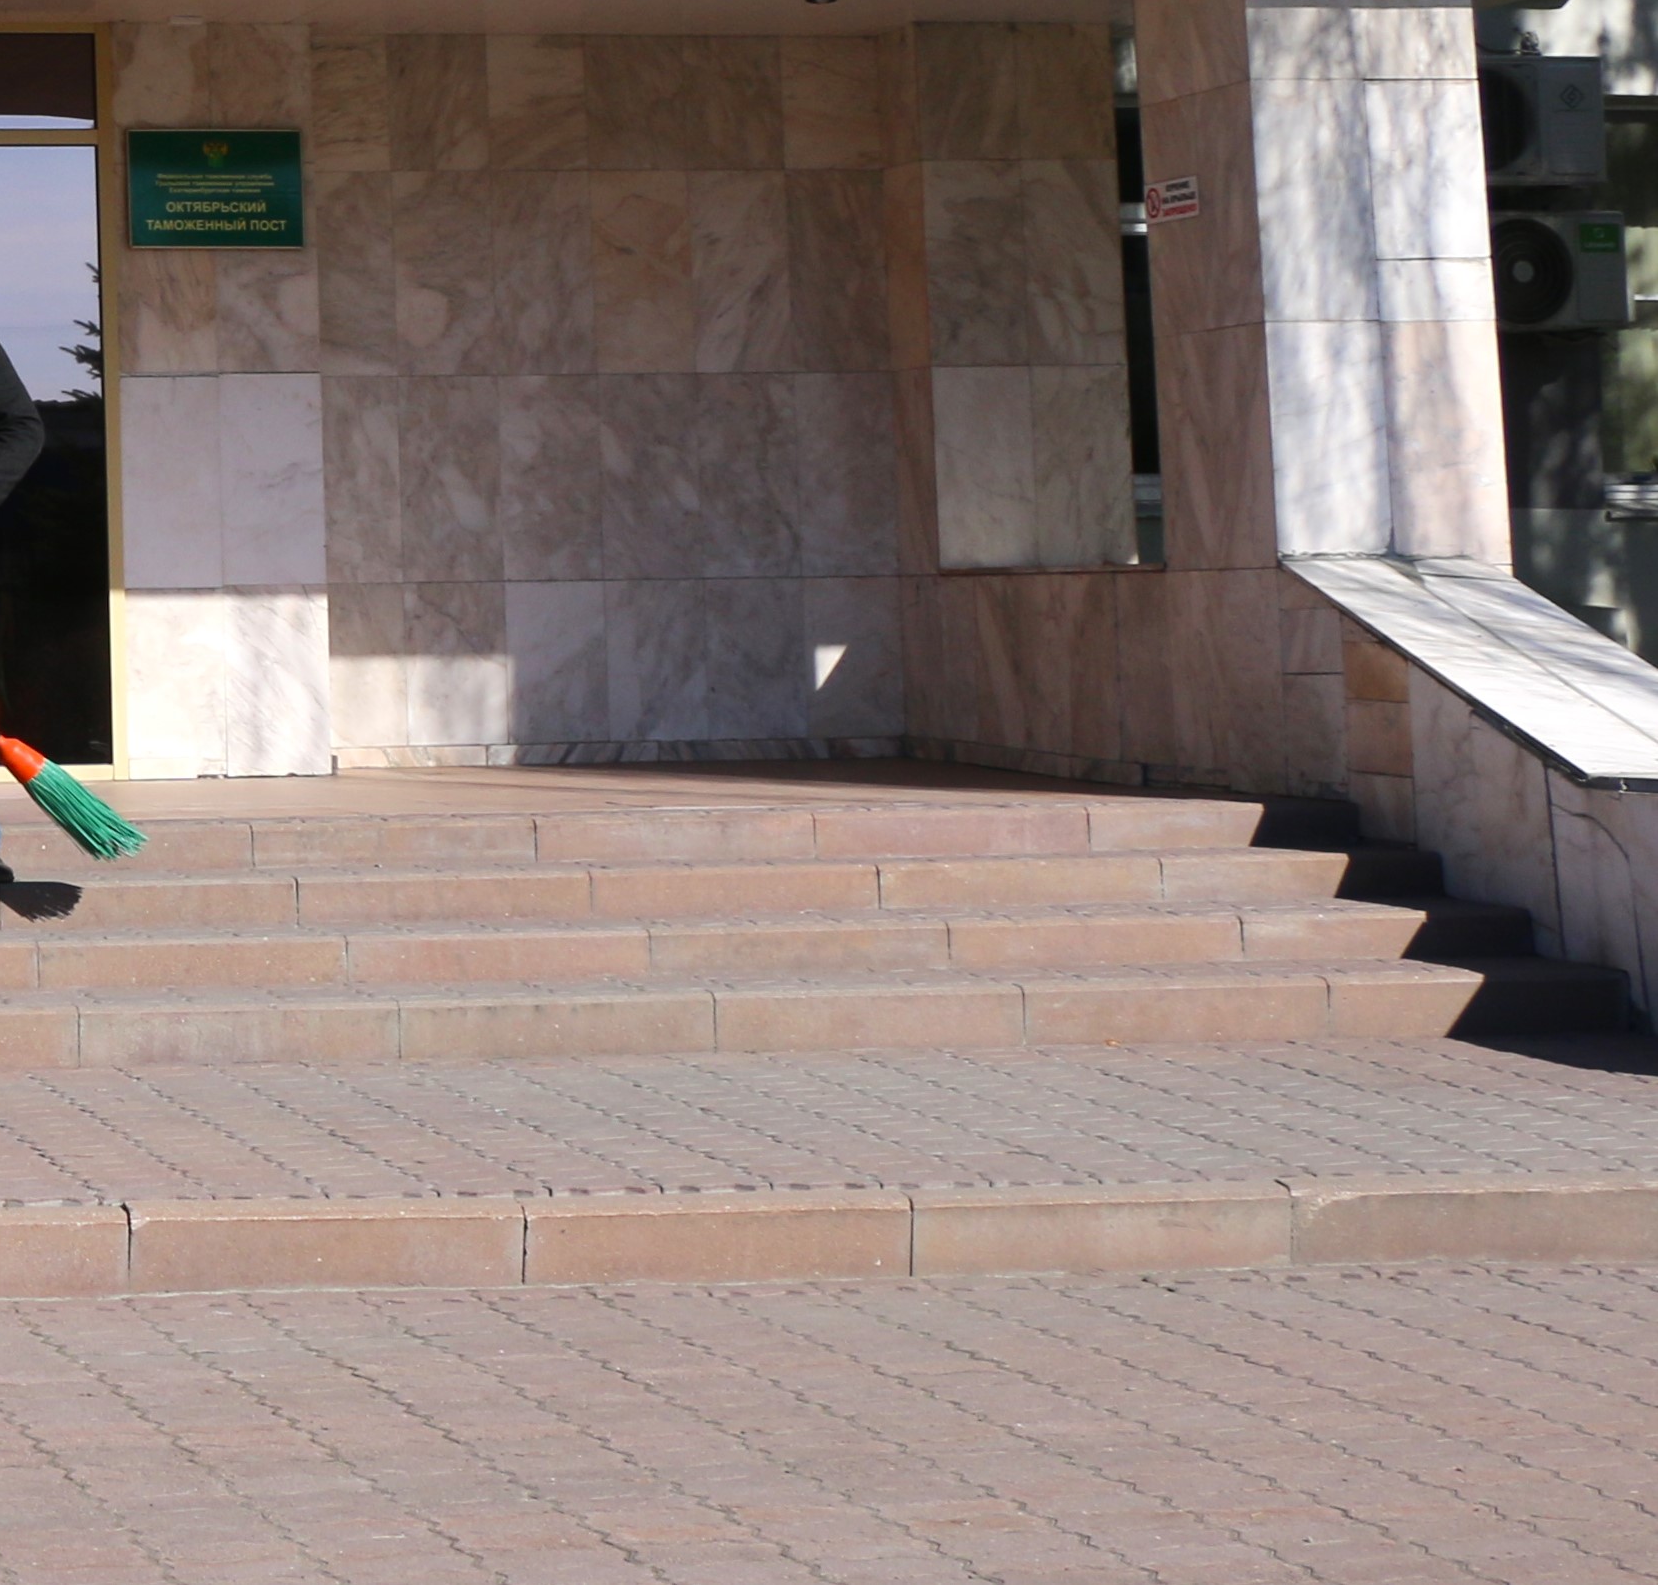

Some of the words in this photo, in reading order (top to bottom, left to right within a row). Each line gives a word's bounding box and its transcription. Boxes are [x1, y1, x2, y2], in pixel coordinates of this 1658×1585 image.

[165, 200, 267, 213] ОКТЯБРЬСКИЙ
[145, 217, 247, 231] ТАМОЖЕННЫЙ
[250, 218, 287, 231] ПОСТ
